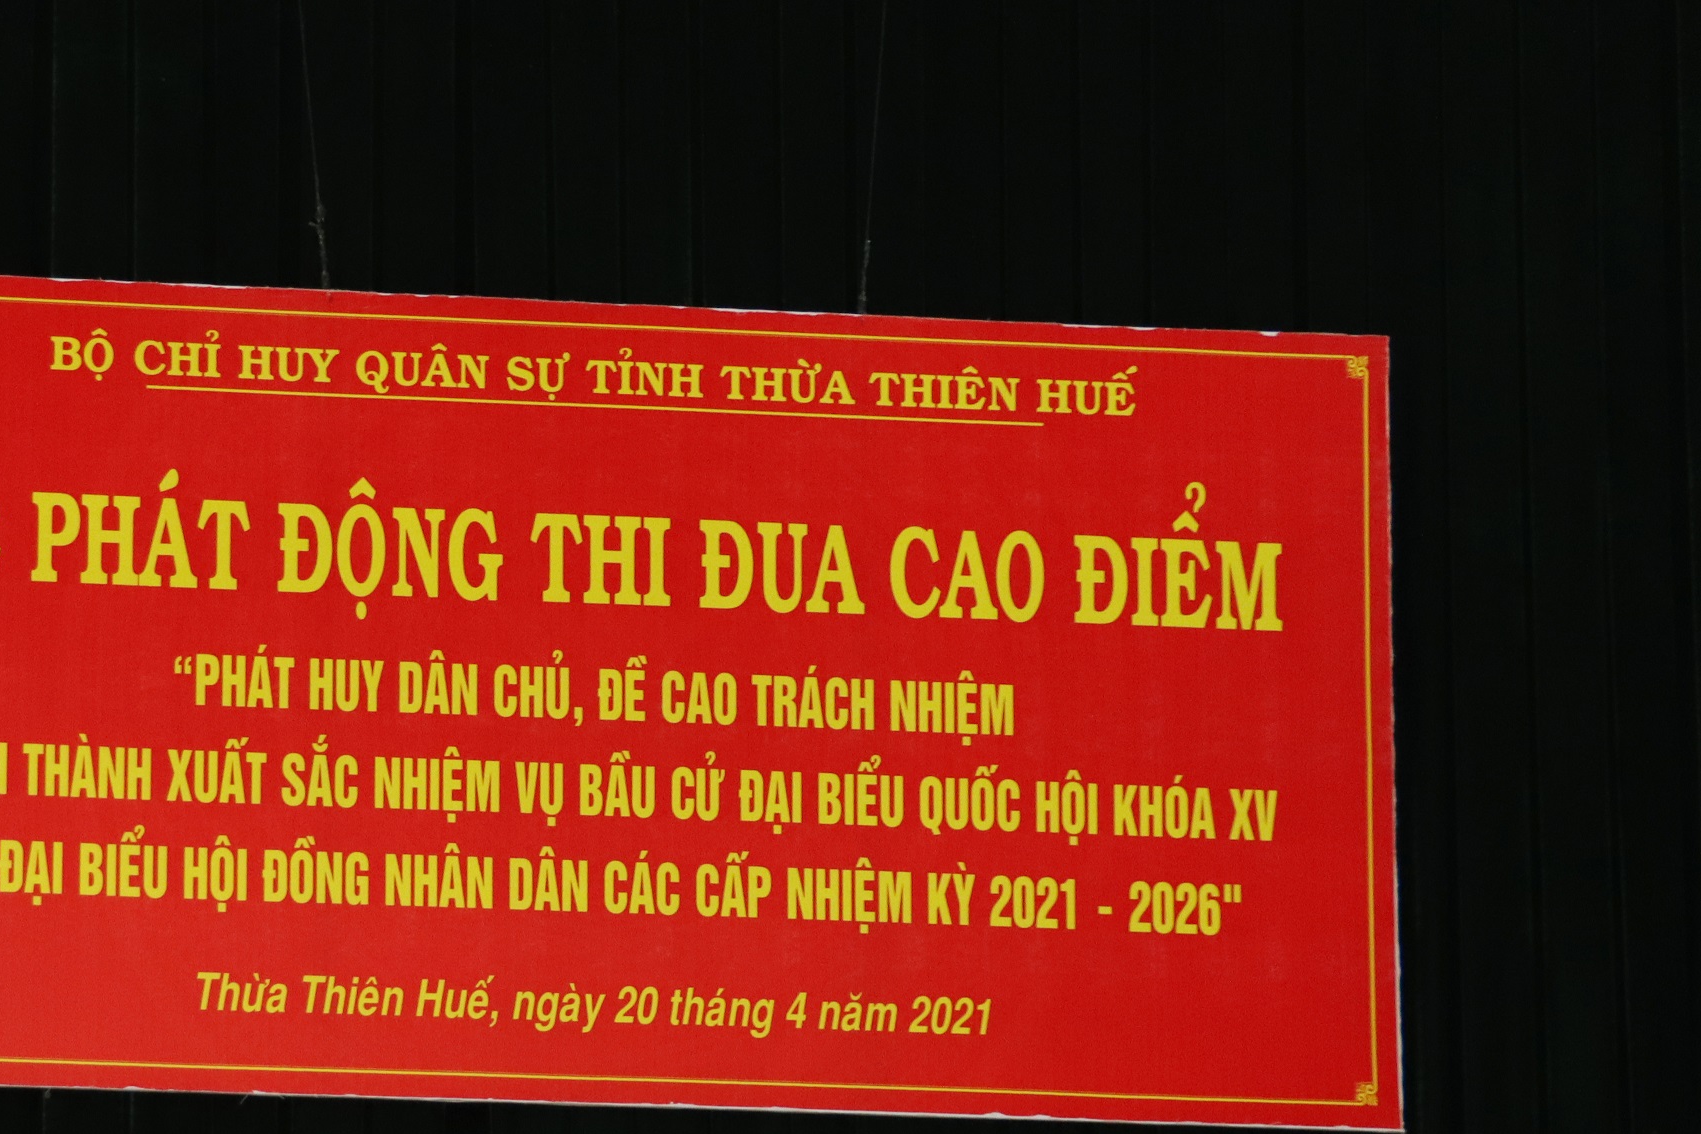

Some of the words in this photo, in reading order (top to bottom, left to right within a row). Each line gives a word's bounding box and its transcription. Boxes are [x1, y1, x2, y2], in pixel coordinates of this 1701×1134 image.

[50, 327, 115, 381] BỘ
[134, 329, 222, 378] CHỈ
[238, 345, 340, 383] HUY
[355, 342, 490, 394] QUÂN
[506, 351, 571, 401] SỰ
[585, 347, 704, 398] TỈNH
[719, 358, 856, 405] THỪA
[868, 365, 1021, 412] THIÊN
[1036, 371, 1136, 417] HUẾ
[30, 468, 251, 591] PHÁT
[277, 476, 504, 620] ĐỘNG
[530, 512, 671, 607] THI
[699, 519, 866, 615] ĐUA
[889, 525, 1045, 623] CAO
[1073, 481, 1283, 632] ĐIỂM
[309, 657, 385, 712] HUY
[398, 649, 478, 716] DÂN
[493, 649, 584, 727] CHỦ,
[597, 655, 648, 722] ĐỀ
[661, 670, 738, 726] CAO
[751, 664, 875, 731] TRÁCH
[890, 670, 1014, 747] NHIỆM
[22, 733, 152, 801] THÀNH
[166, 736, 268, 805] XUẤT
[281, 734, 359, 809] SẮC
[374, 745, 501, 824] NHIỆM
[514, 761, 564, 827] VỤ
[579, 750, 656, 819] BẦU
[671, 750, 726, 822] CỬ
[738, 769, 803, 835] ĐẠI
[817, 754, 904, 828] BIỂU
[919, 764, 1021, 836] QUỐC
[1035, 769, 1098, 846] HỘI
[1113, 774, 1216, 840] KHÓA
[1229, 788, 1278, 842] XV
[78, 824, 168, 899] BIỂU
[183, 834, 248, 913] HỘI
[261, 835, 370, 906] ĐỒNG
[384, 842, 494, 910] NHÂN
[508, 845, 589, 913] DÂN
[603, 849, 680, 916] CÁC
[695, 850, 772, 919] CẤP
[787, 856, 912, 934] NHIỆM
[927, 861, 976, 926] KỲ
[989, 875, 1076, 930] 2021
[1098, 905, 1113, 915] -
[196, 971, 288, 1014] Thừa
[302, 974, 404, 1017] Thiên
[415, 974, 499, 1028] Huế,
[512, 982, 606, 1033] ngày
[613, 985, 659, 1025] 20
[670, 987, 775, 1039] tháng
[785, 991, 807, 1029] 4
[818, 992, 898, 1032] năm
[908, 995, 992, 1035] 2021
